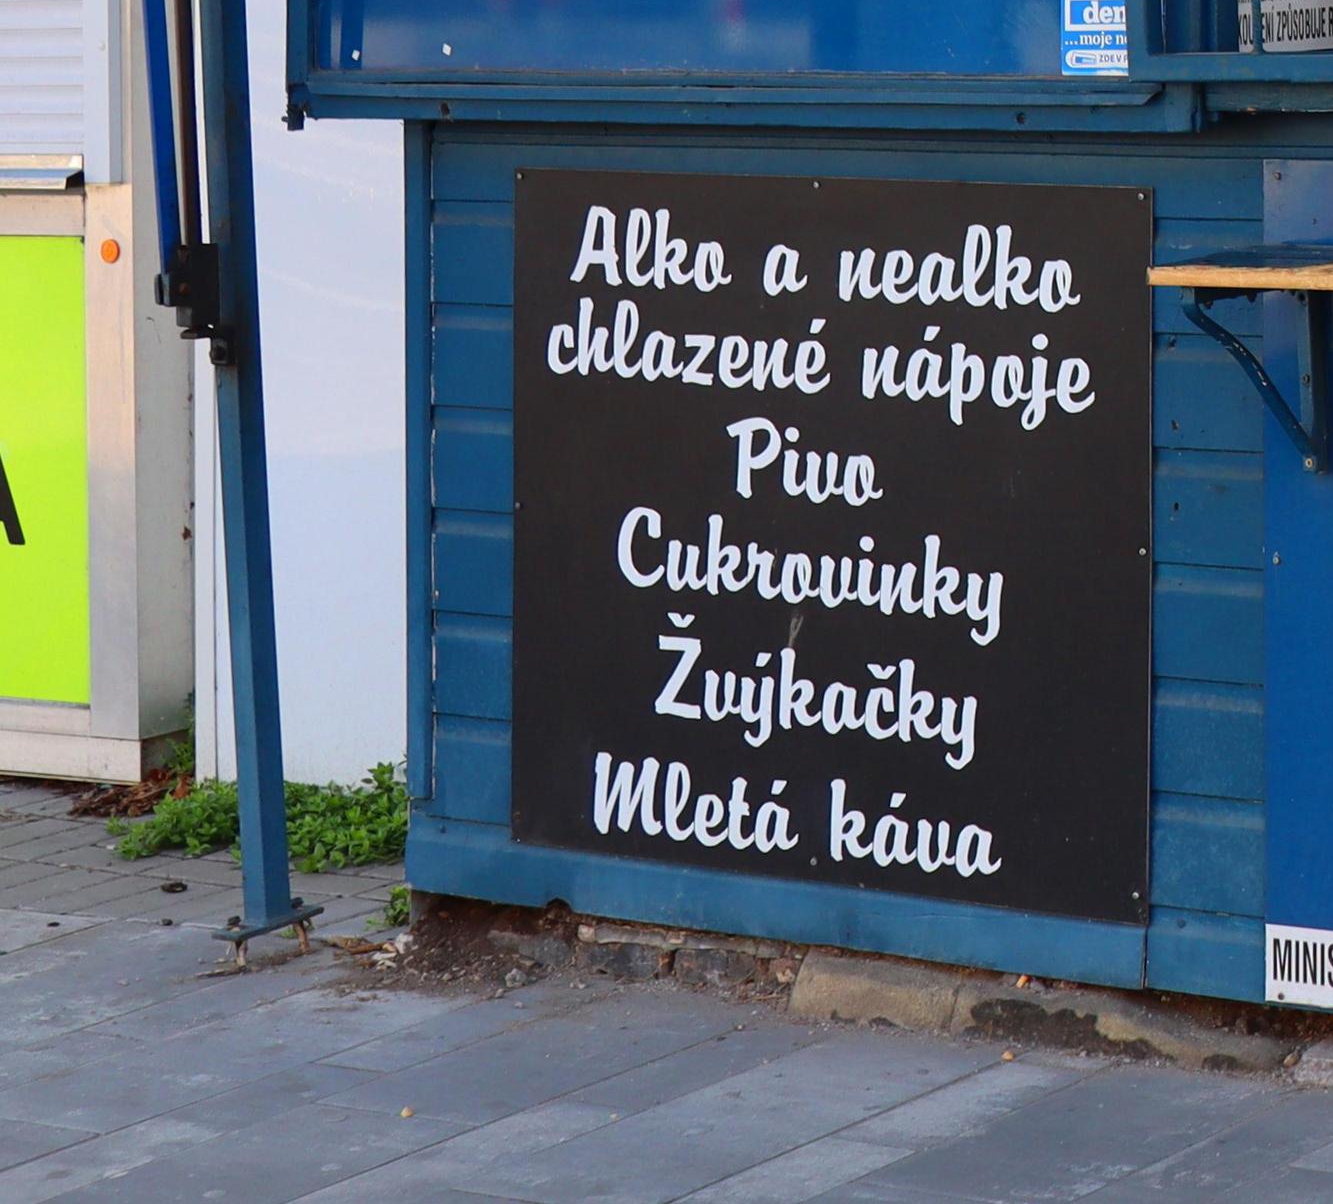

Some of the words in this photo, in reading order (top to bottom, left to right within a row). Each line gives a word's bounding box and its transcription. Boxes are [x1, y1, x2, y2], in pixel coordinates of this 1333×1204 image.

[1239, 6, 1275, 46] KOUENÍ
[1276, 3, 1327, 42] ZPŮSOBUJE
[570, 205, 732, 292] Alko
[763, 244, 807, 295] a
[839, 225, 1080, 312] nealko
[547, 297, 831, 394] chlazené
[862, 326, 1095, 430] nápoje
[726, 417, 883, 507] Pivo
[617, 506, 1003, 646] Cukrovinky
[654, 612, 977, 770] Žvýkačky
[593, 751, 798, 853] Mletá
[830, 779, 1001, 877] káva
